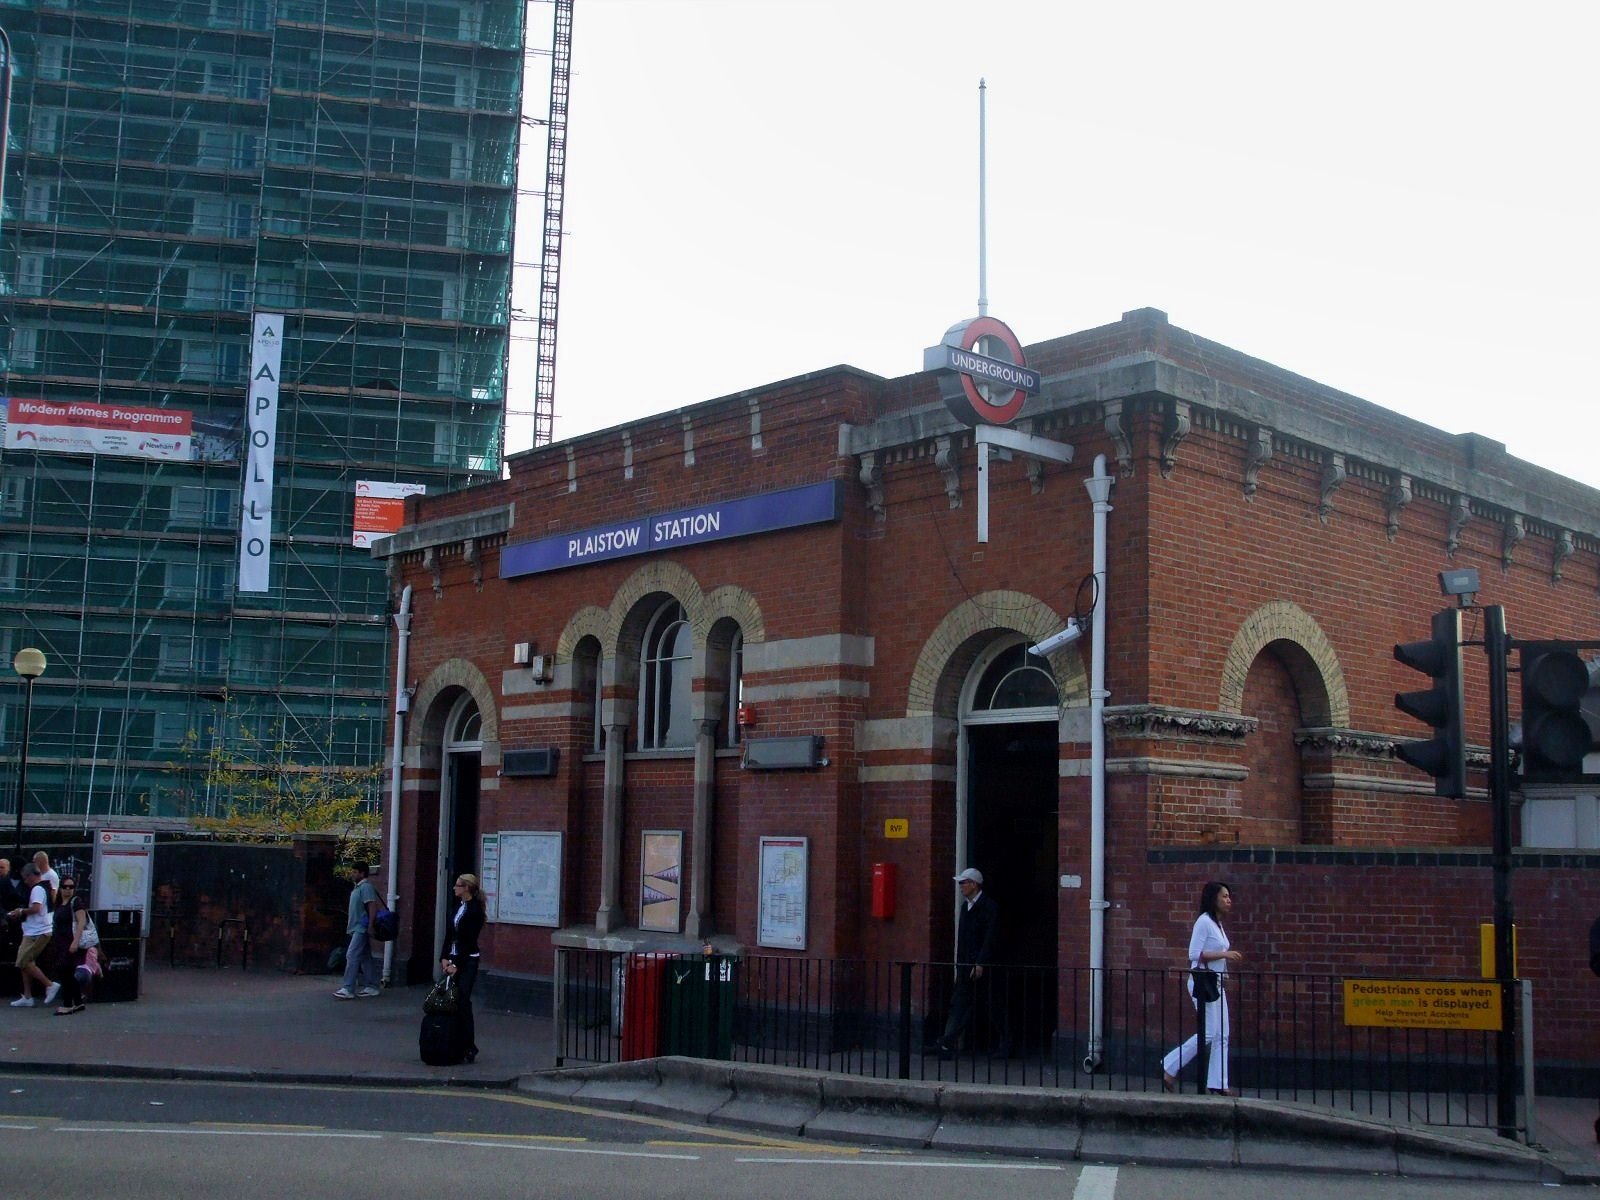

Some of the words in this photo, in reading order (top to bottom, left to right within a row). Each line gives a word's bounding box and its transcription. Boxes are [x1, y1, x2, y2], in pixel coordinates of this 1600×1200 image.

[951, 352, 1034, 388] UNDERGROUND
[18, 402, 66, 416] Modern
[68, 406, 109, 419] Homes
[112, 409, 183, 425] Programme
[146, 441, 174, 450] Newham
[247, 362, 275, 556] APOLLO
[568, 527, 640, 558] PLAISTOW
[654, 511, 720, 542] STATION
[1352, 984, 1420, 995] Pedestrians
[1425, 987, 1456, 996] cross
[1460, 986, 1492, 997] when
[1353, 998, 1386, 1008] green
[1390, 999, 1414, 1007] man
[1418, 998, 1428, 1008] is
[1375, 1009, 1394, 1017] Help
[1396, 1009, 1427, 1017] Prevent
[1430, 1010, 1469, 1019] Accidents
